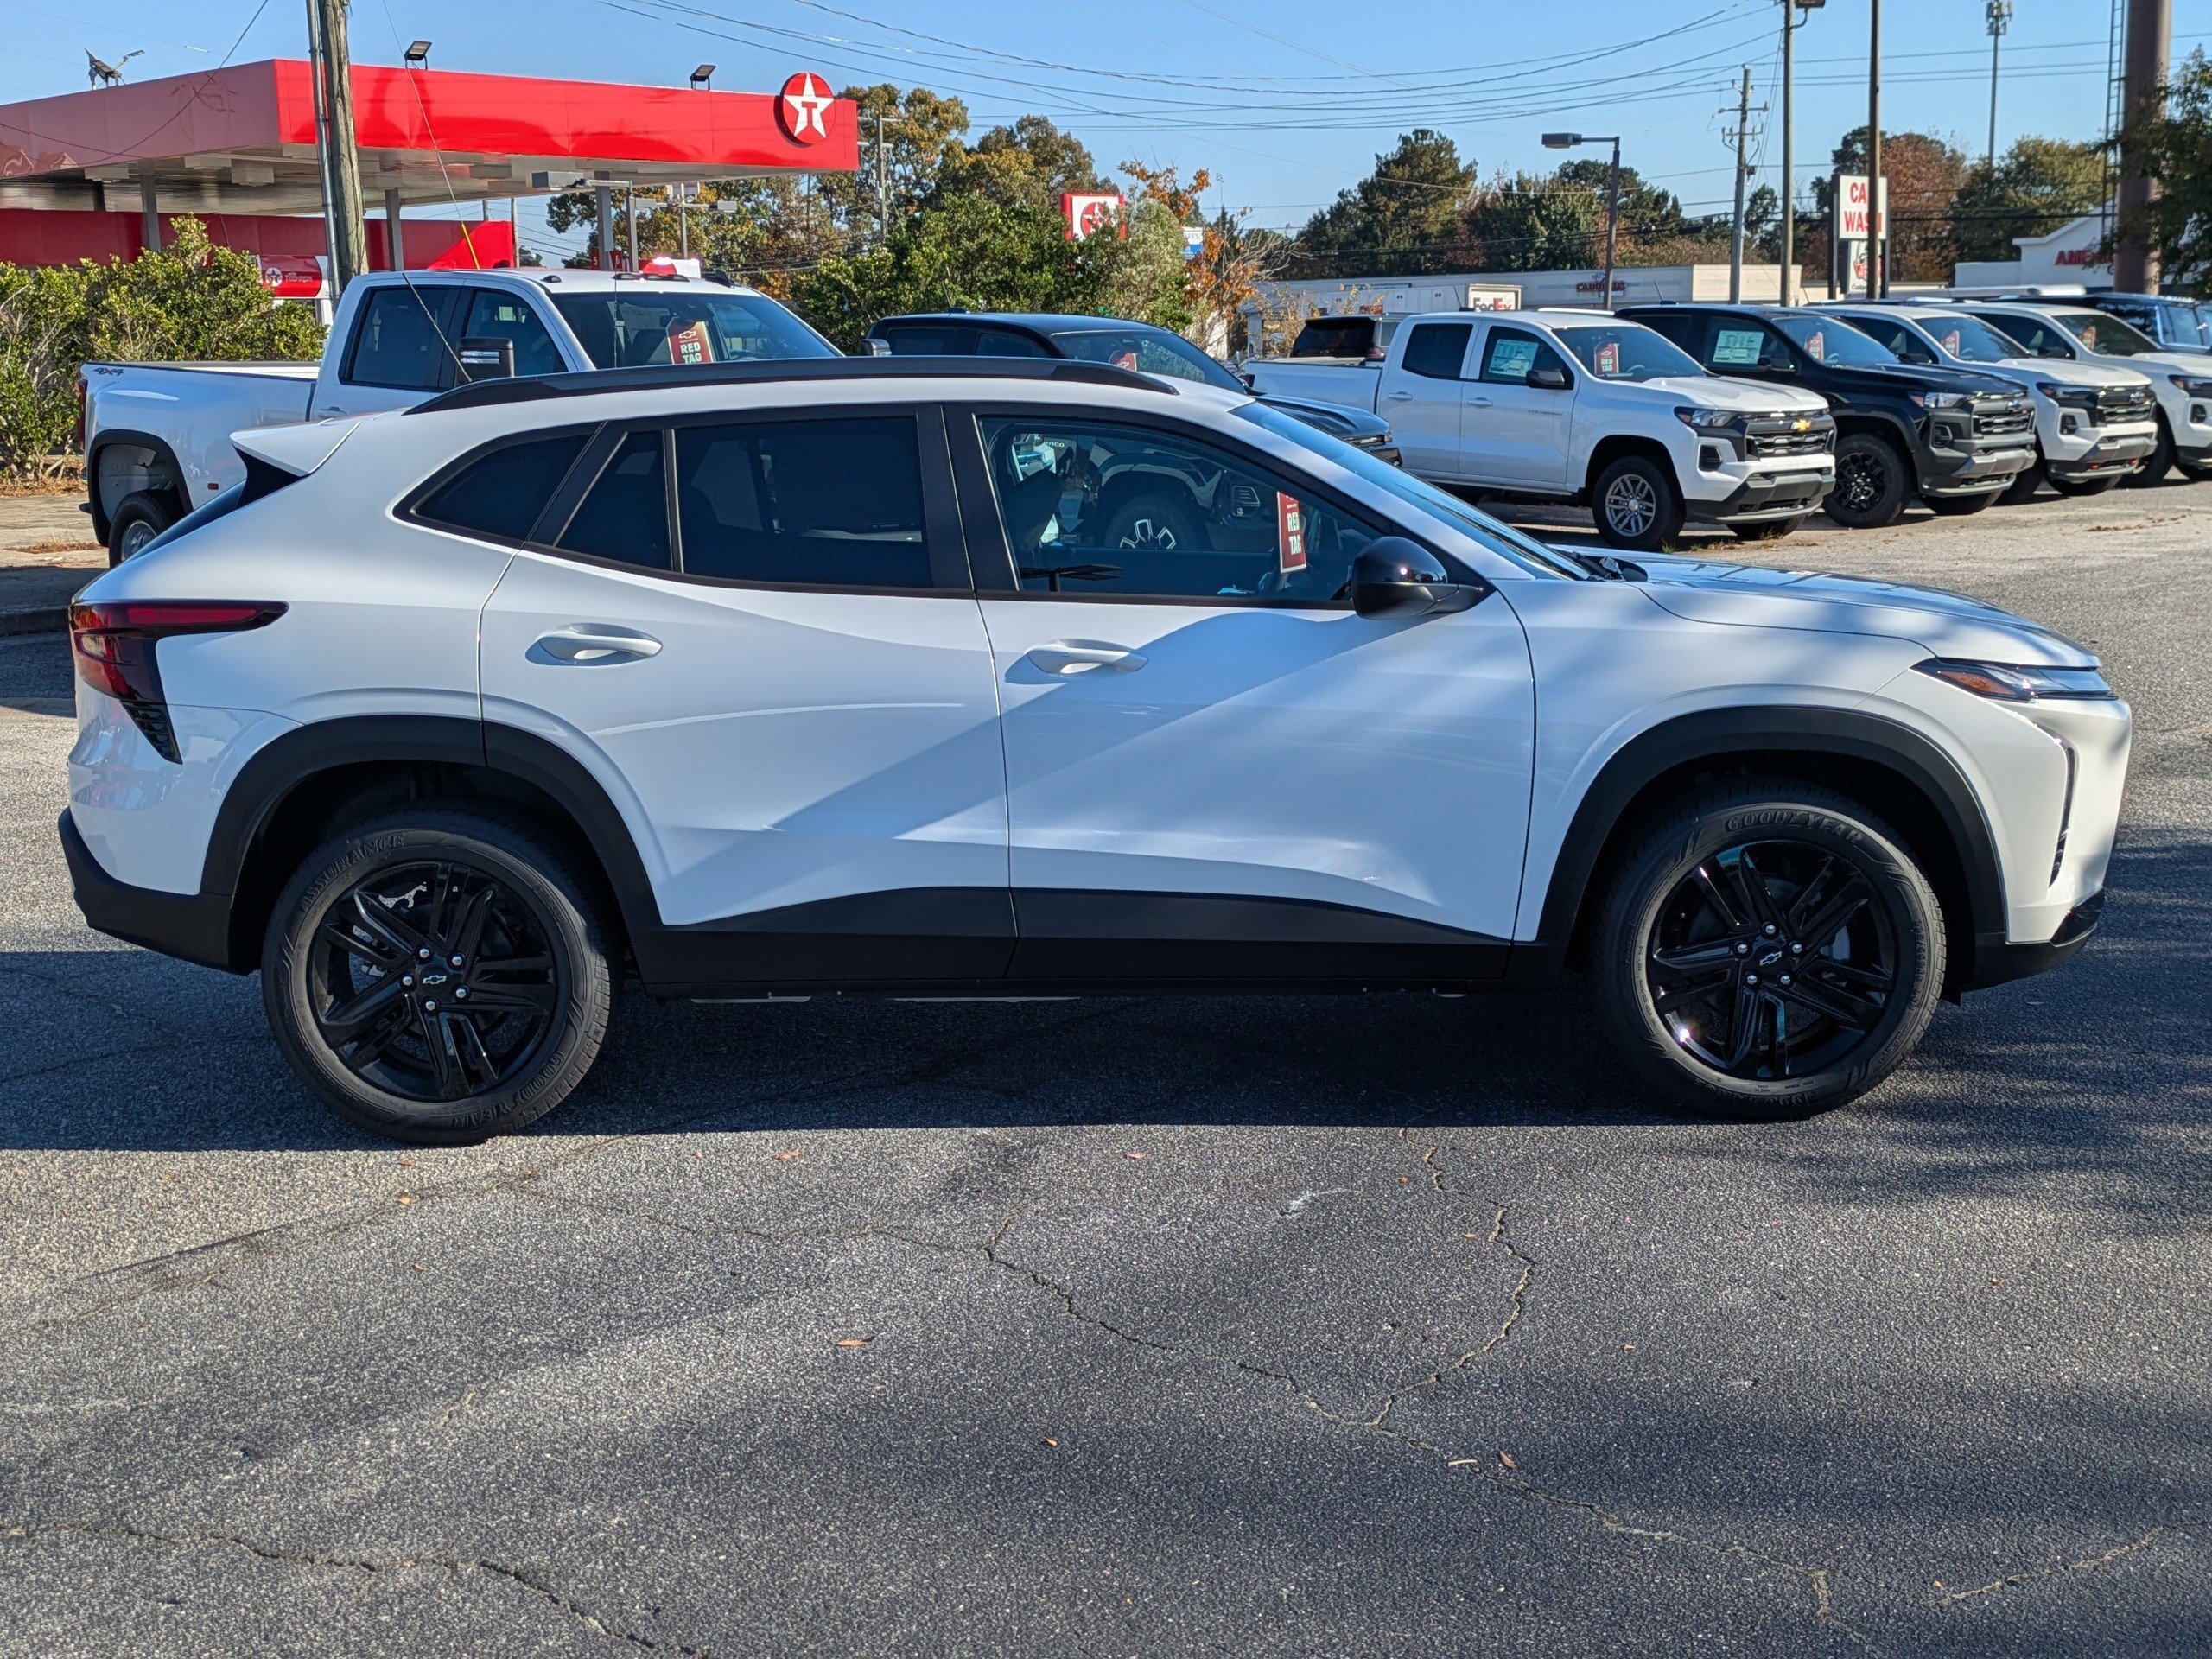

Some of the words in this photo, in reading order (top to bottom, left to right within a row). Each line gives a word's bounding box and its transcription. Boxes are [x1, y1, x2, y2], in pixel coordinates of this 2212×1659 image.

[1850, 181, 1868, 204] CA
[680, 342, 701, 354] RED
[683, 353, 702, 364] TAG
[1288, 535, 1302, 555] TAG
